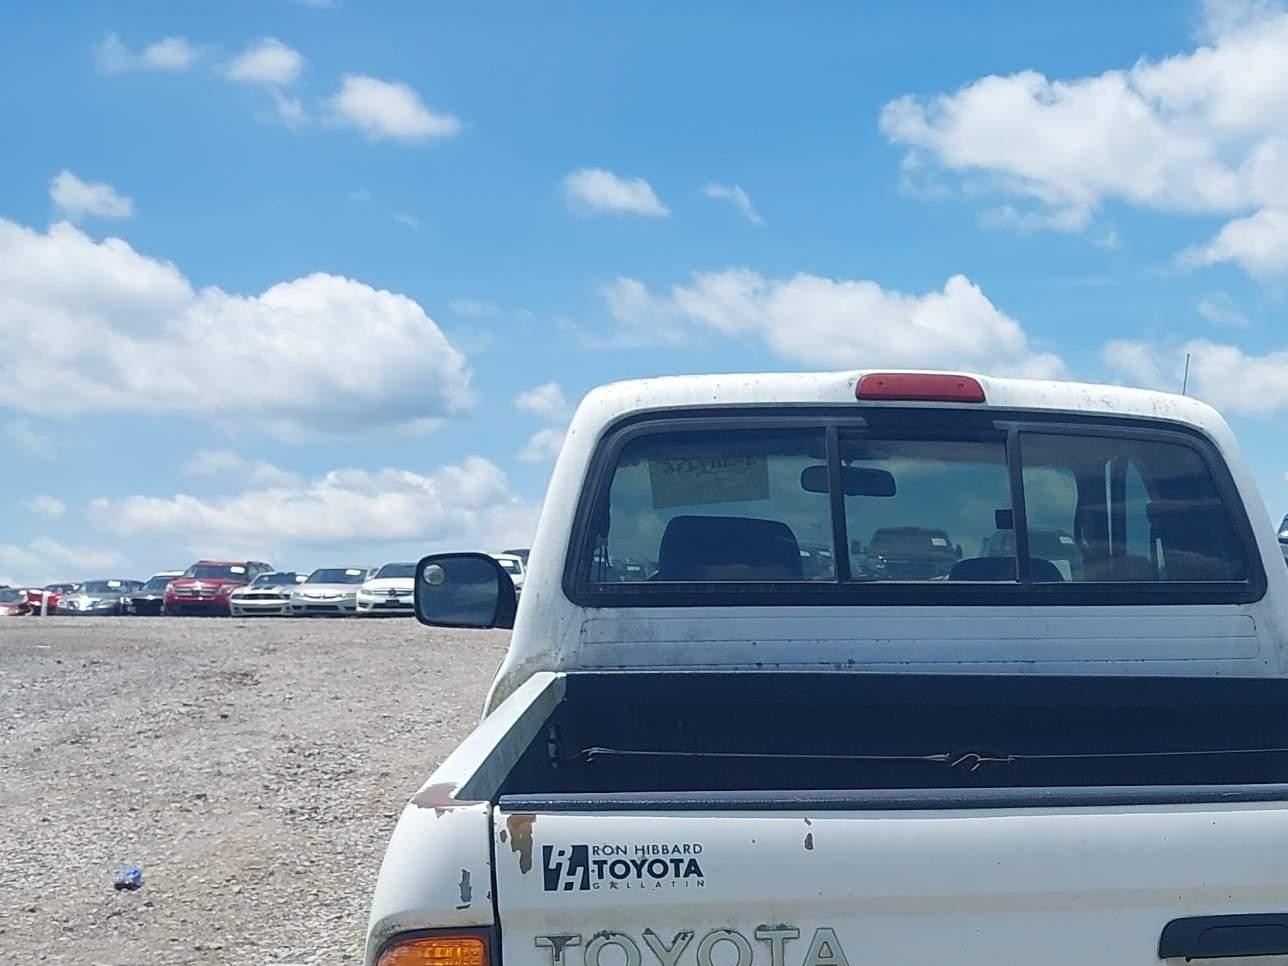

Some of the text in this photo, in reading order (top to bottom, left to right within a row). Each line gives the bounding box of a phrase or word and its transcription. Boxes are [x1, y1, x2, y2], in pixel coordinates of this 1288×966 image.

[592, 843, 703, 856] RON HIBBARD
[593, 857, 704, 879] TOYOTA
